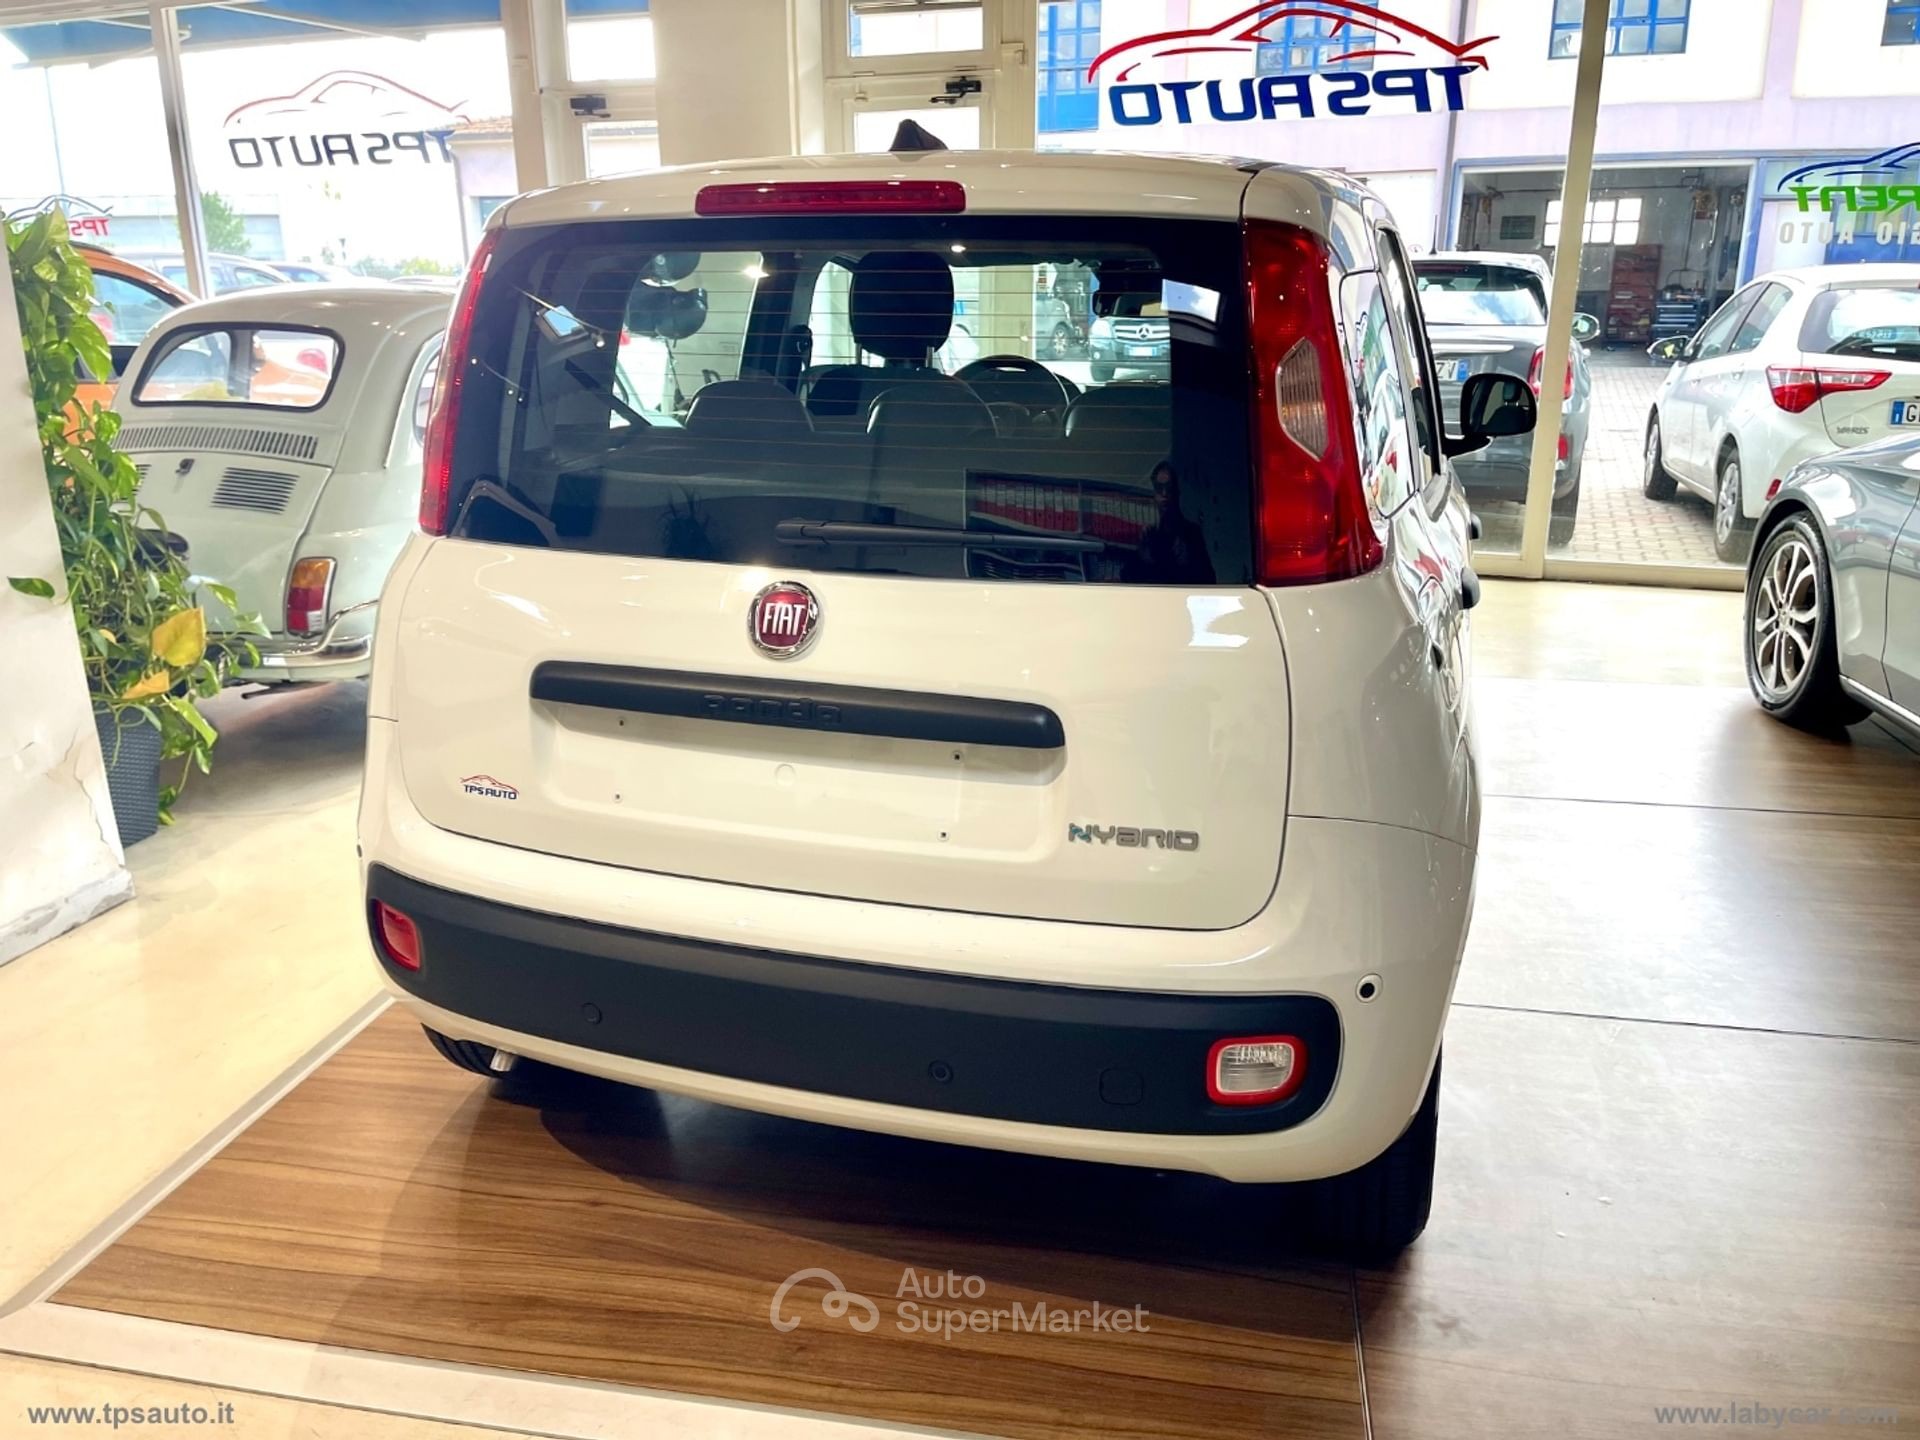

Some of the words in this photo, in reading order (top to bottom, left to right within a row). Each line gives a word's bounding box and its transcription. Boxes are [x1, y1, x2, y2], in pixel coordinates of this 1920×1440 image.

[1906, 404, 1920, 423] G
[762, 602, 806, 636] FIAT
[464, 784, 484, 796] TPS
[485, 787, 517, 800] AUTO
